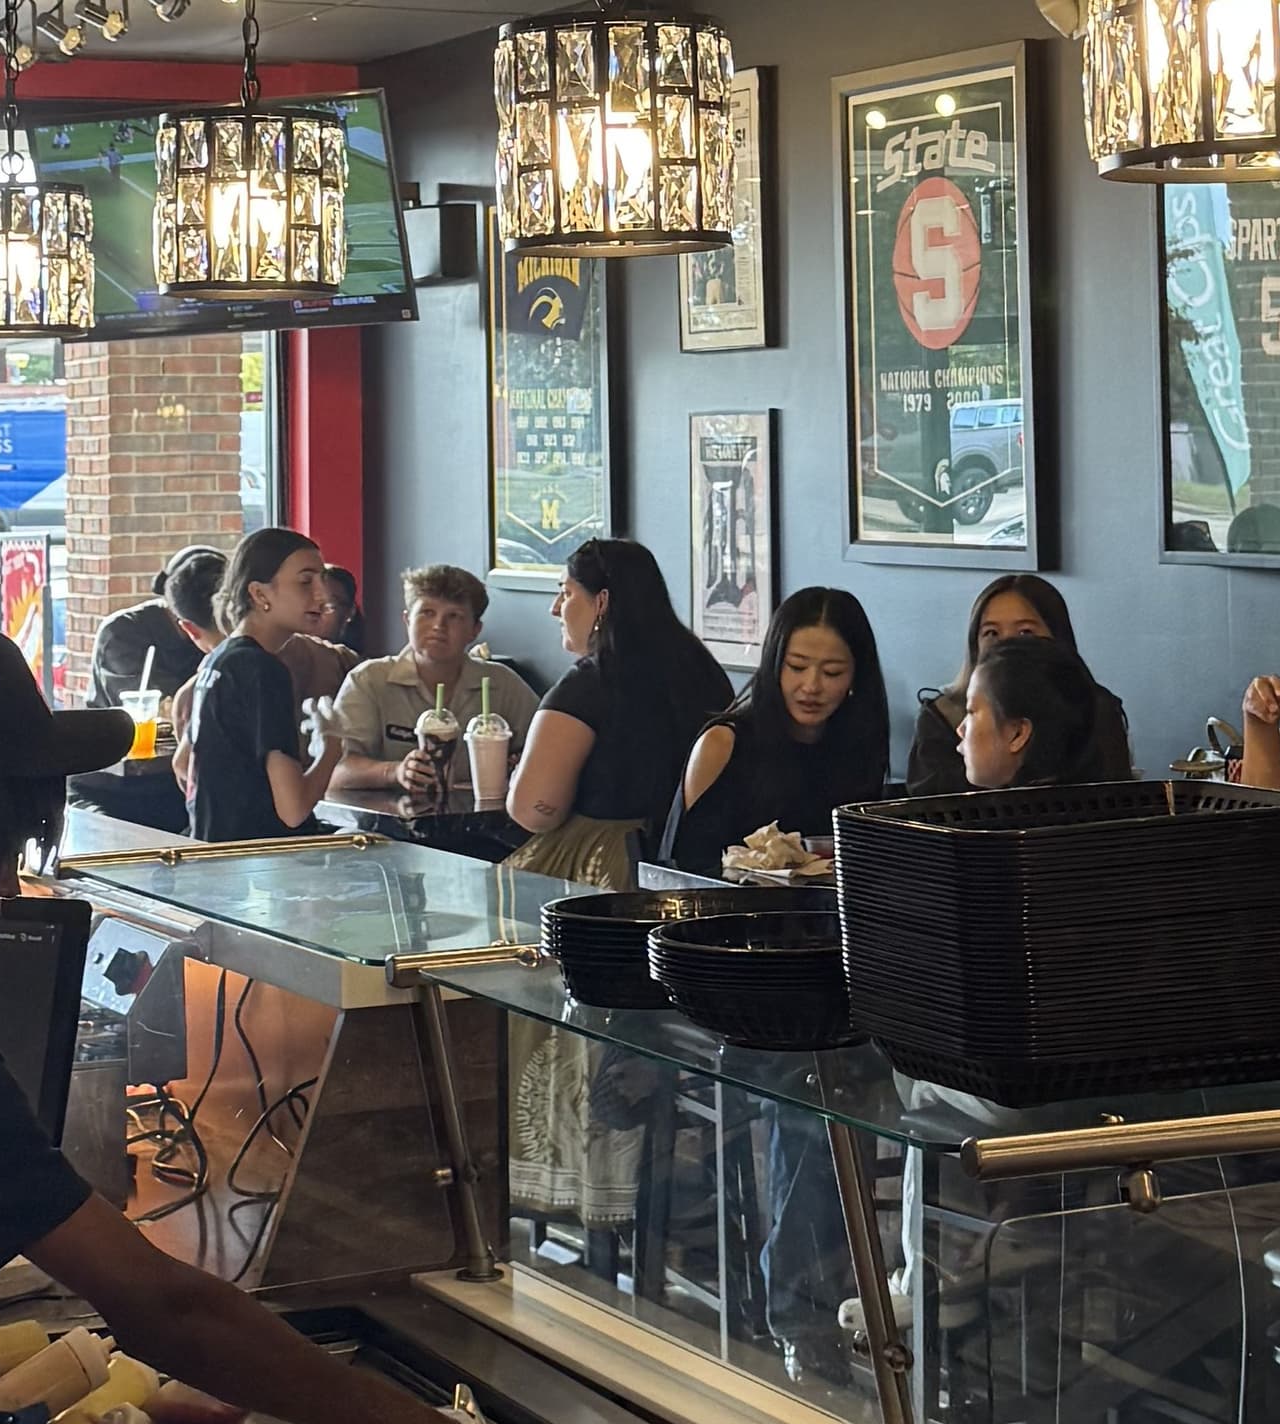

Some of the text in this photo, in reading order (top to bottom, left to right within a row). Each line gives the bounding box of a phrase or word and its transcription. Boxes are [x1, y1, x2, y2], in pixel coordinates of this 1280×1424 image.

[876, 119, 995, 193] State
[910, 195, 964, 331] S
[880, 364, 1004, 392] NATIONAL CHAMPIONS
[902, 393, 932, 413] 1979
[1193, 310, 1252, 452] Great
